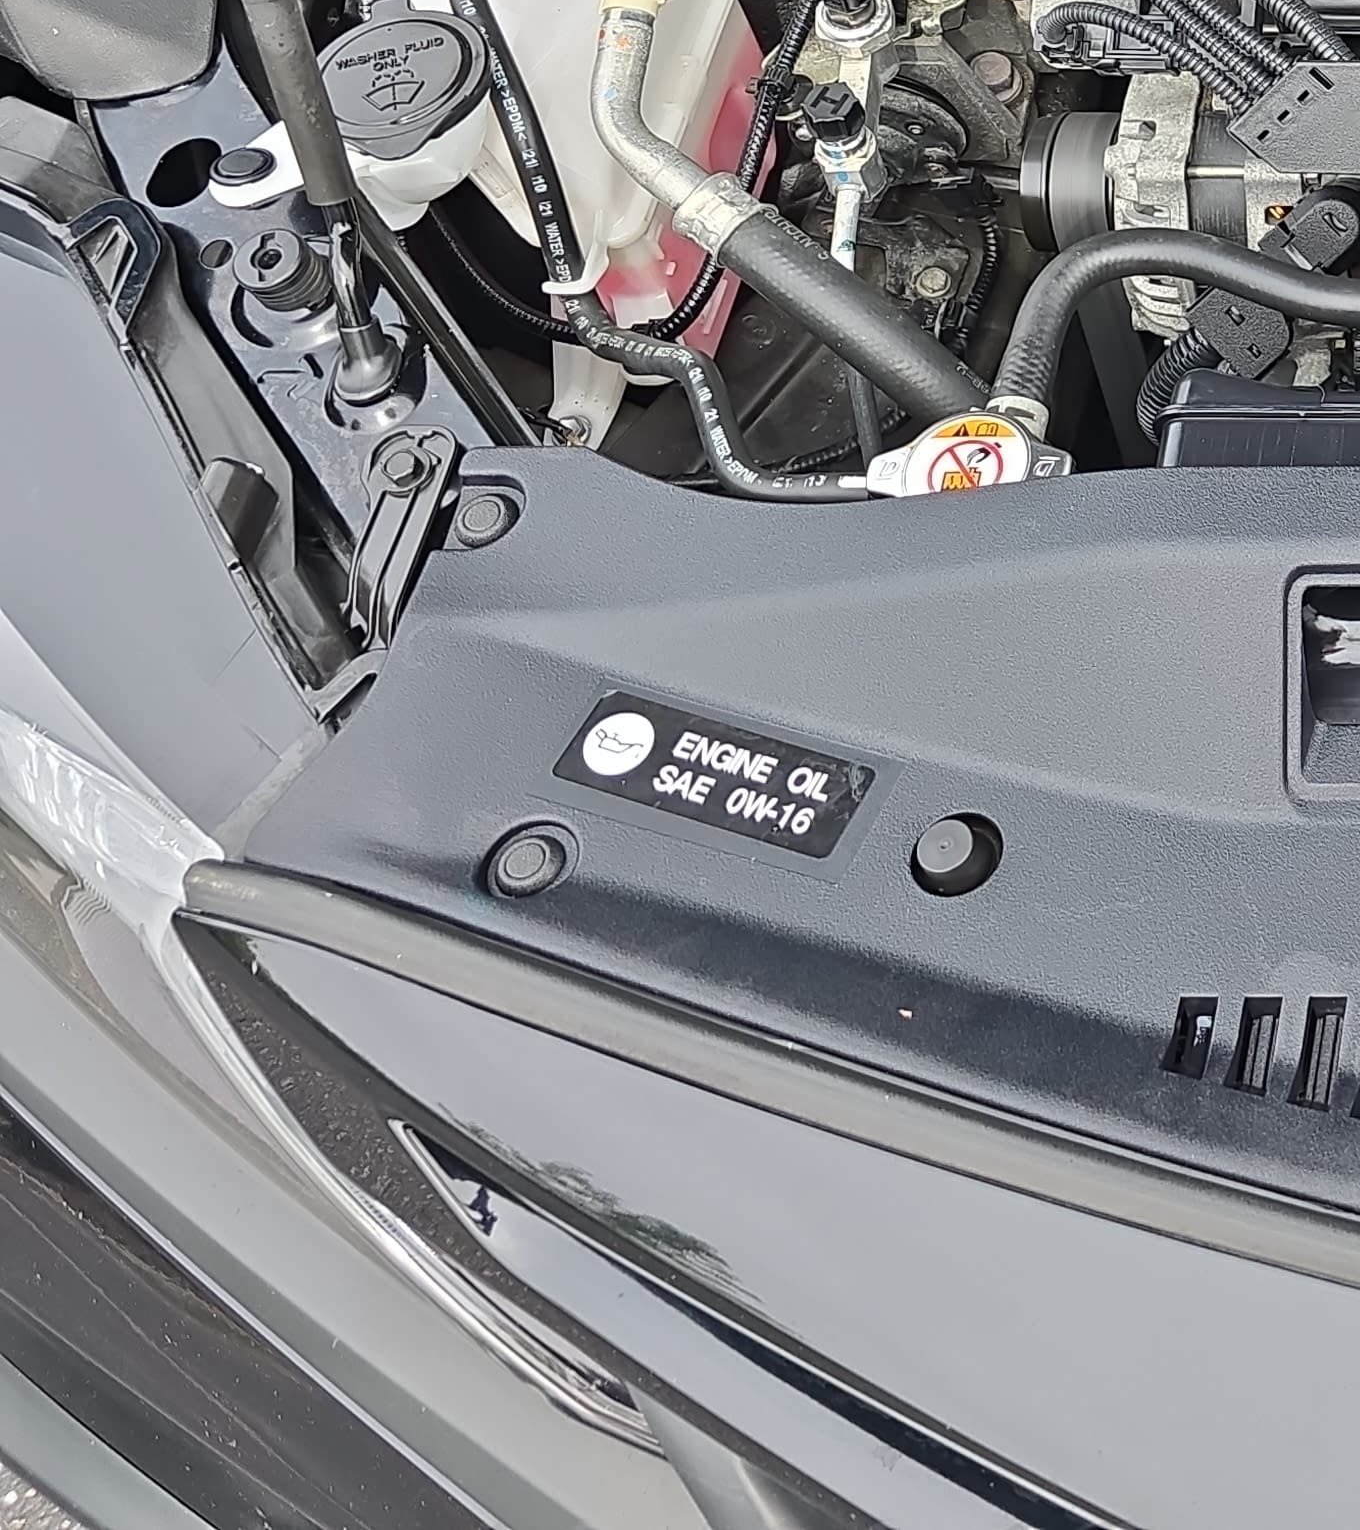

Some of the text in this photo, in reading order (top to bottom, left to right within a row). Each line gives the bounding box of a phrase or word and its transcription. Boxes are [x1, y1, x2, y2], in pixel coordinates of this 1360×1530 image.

[335, 36, 445, 71] WASHER FLUID
[372, 55, 410, 72] ONLY
[810, 86, 850, 115] H
[501, 89, 528, 142] >EPDM<
[544, 221, 565, 258] WATER
[555, 258, 572, 283] >EPD
[709, 424, 733, 461] WATER
[671, 731, 830, 803] ENGINE OIL
[652, 765, 816, 836] SAE 0W-16
